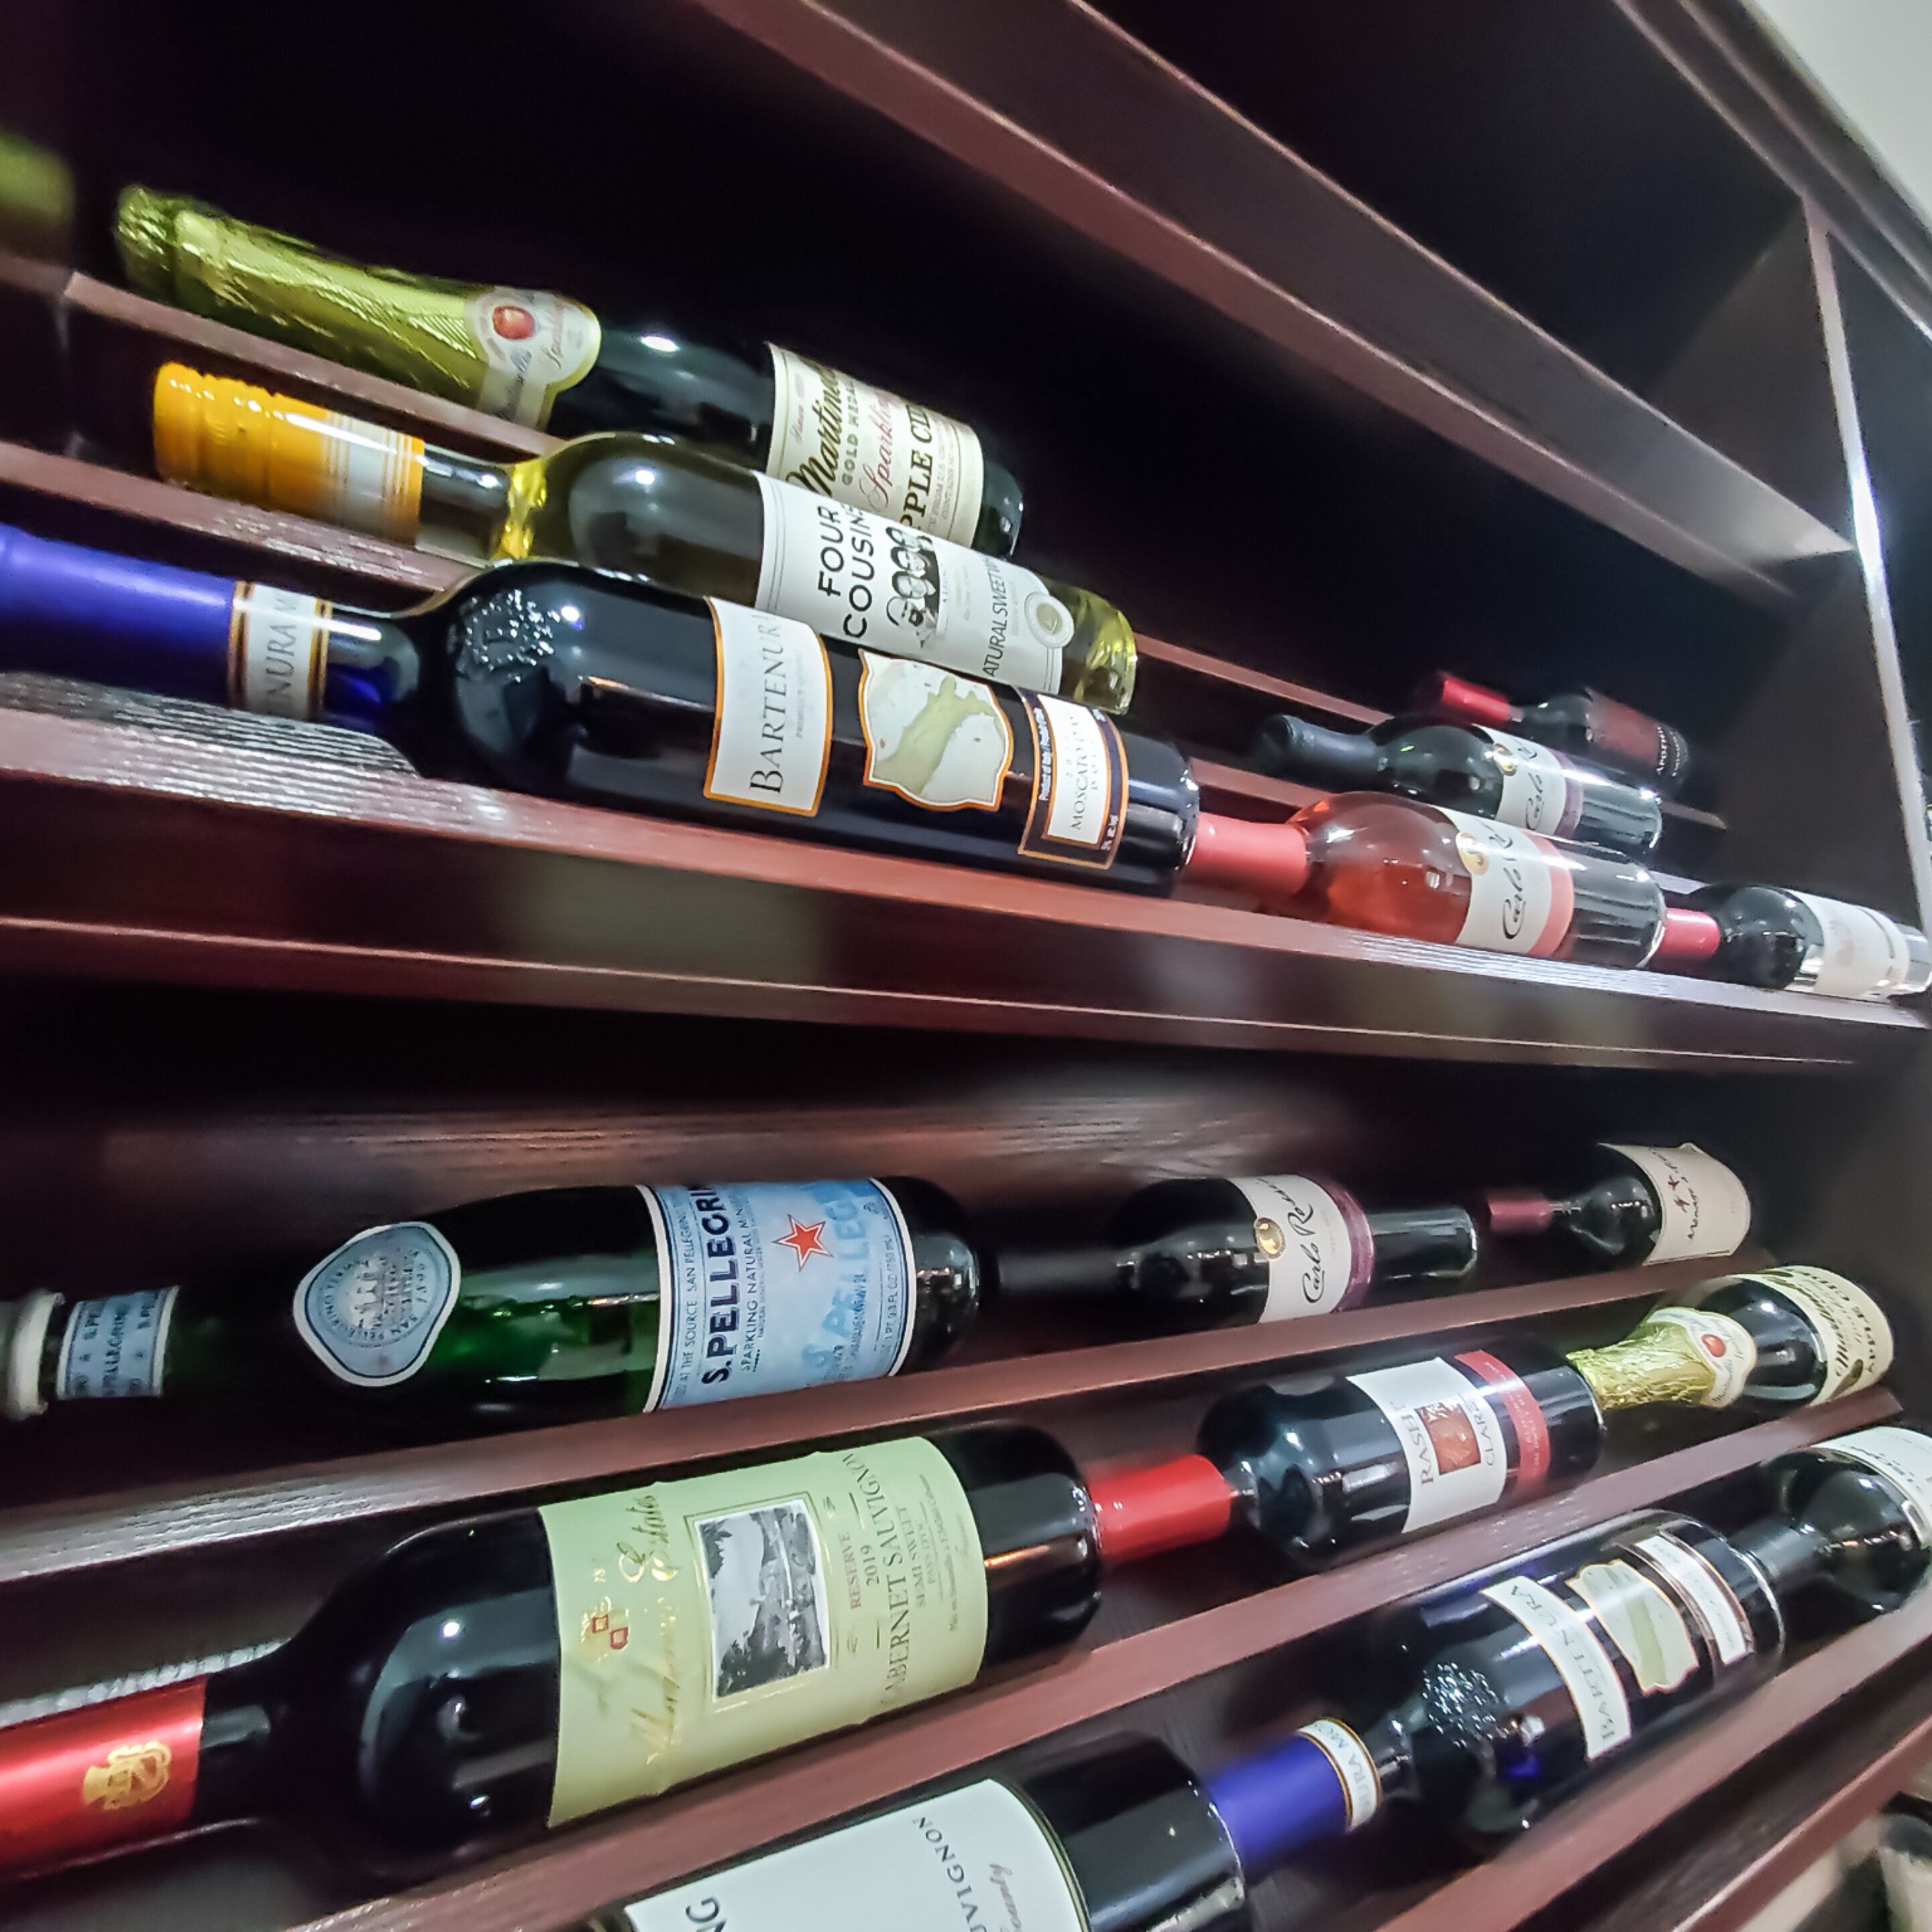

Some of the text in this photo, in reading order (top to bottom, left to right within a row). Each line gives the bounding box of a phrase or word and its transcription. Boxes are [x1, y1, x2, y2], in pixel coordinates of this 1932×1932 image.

[842, 433, 859, 485] GOLD
[900, 449, 933, 531] PPLE
[818, 506, 845, 597] FOUR
[982, 614, 1009, 678] ATURAL
[687, 1267, 698, 1292] SAN
[688, 1187, 739, 1385] S.PELLEGRI
[743, 1237, 759, 1295] NATURAL
[740, 1301, 759, 1372] SPARKLING
[837, 1532, 863, 1610] RESERVE
[859, 1544, 881, 1586] 2019
[912, 1817, 987, 1932] VIGNON
